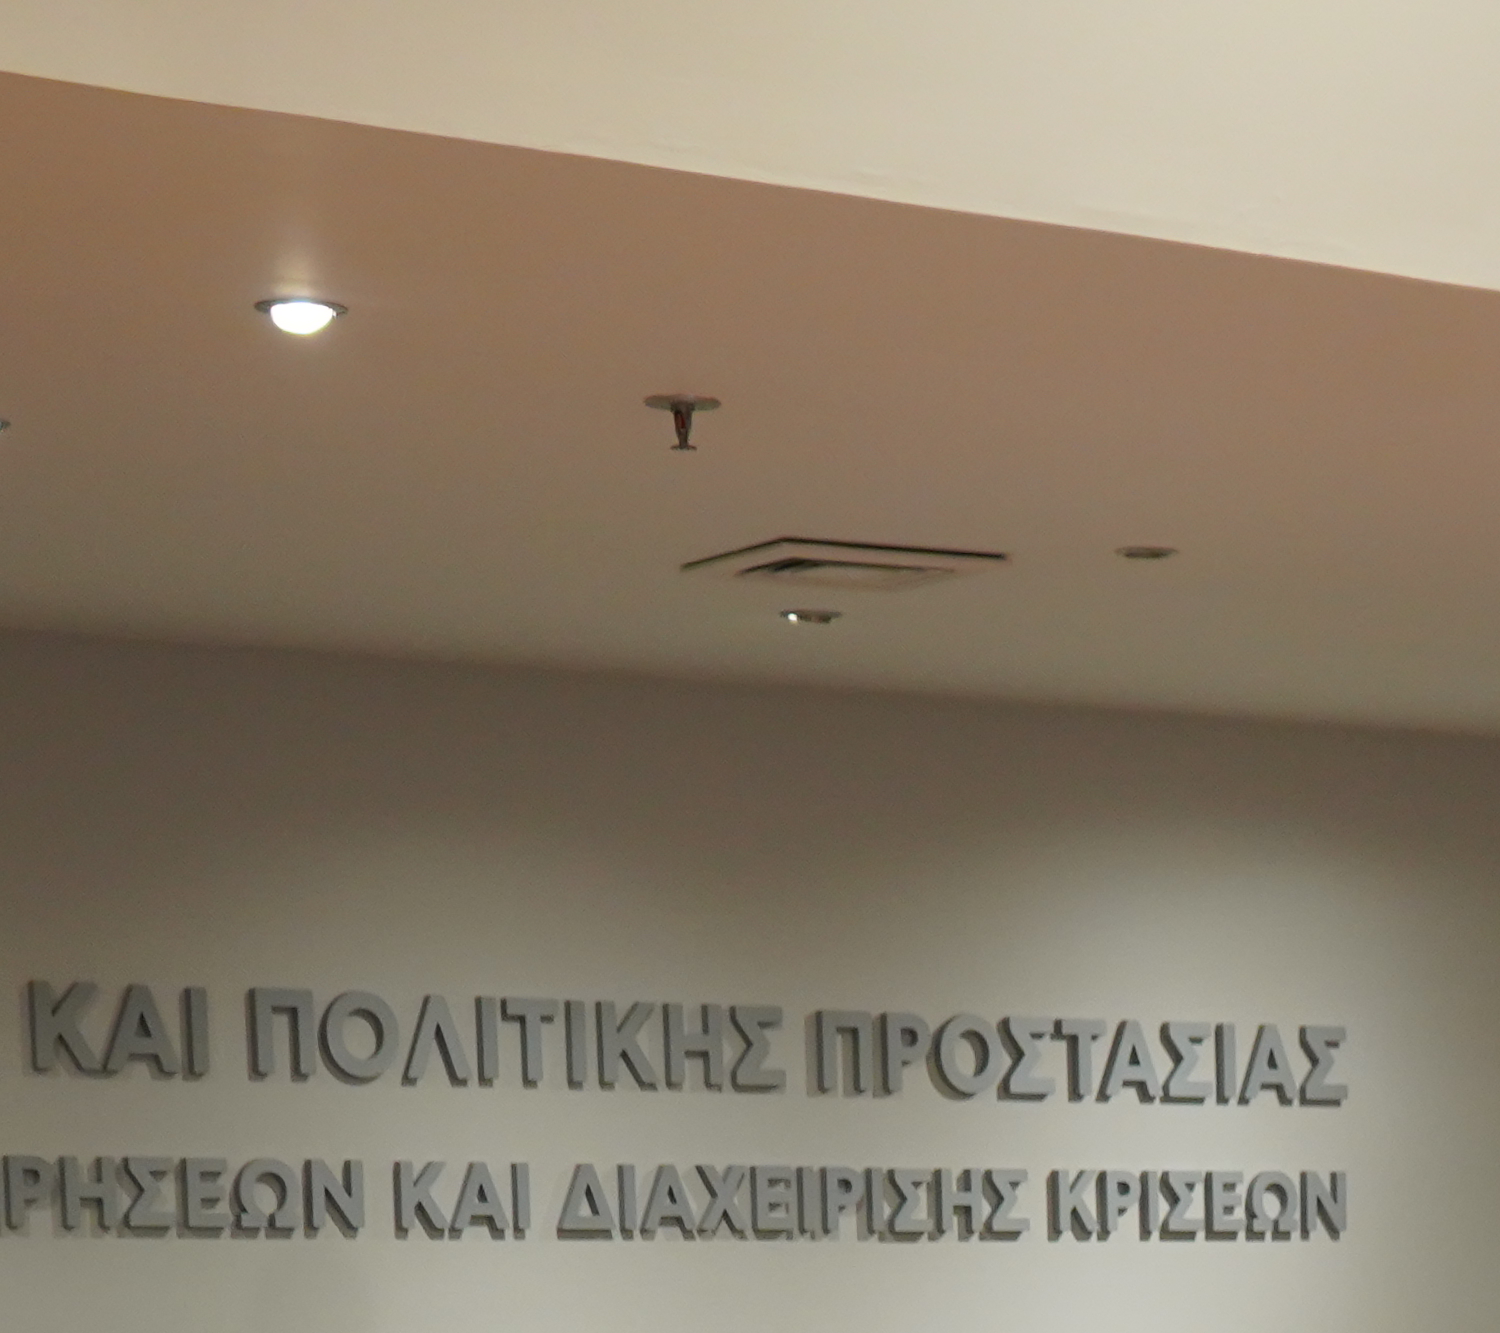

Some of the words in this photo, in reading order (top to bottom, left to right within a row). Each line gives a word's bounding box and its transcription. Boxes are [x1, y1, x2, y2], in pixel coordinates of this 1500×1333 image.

[26, 979, 211, 1082] ΚΑΙ
[245, 987, 787, 1094] ΠΟΛΙΤΙΚΗΣ
[806, 1010, 1349, 1108] ΠΡΟΣΤΑΣΙΑΣ
[393, 1160, 531, 1241] ΚΑΙ
[556, 1163, 1031, 1243] ΔΙΑΧΕΙΡΙΣΗΣ
[1046, 1169, 1347, 1243] ΚΡΙΣΕΩΝ
